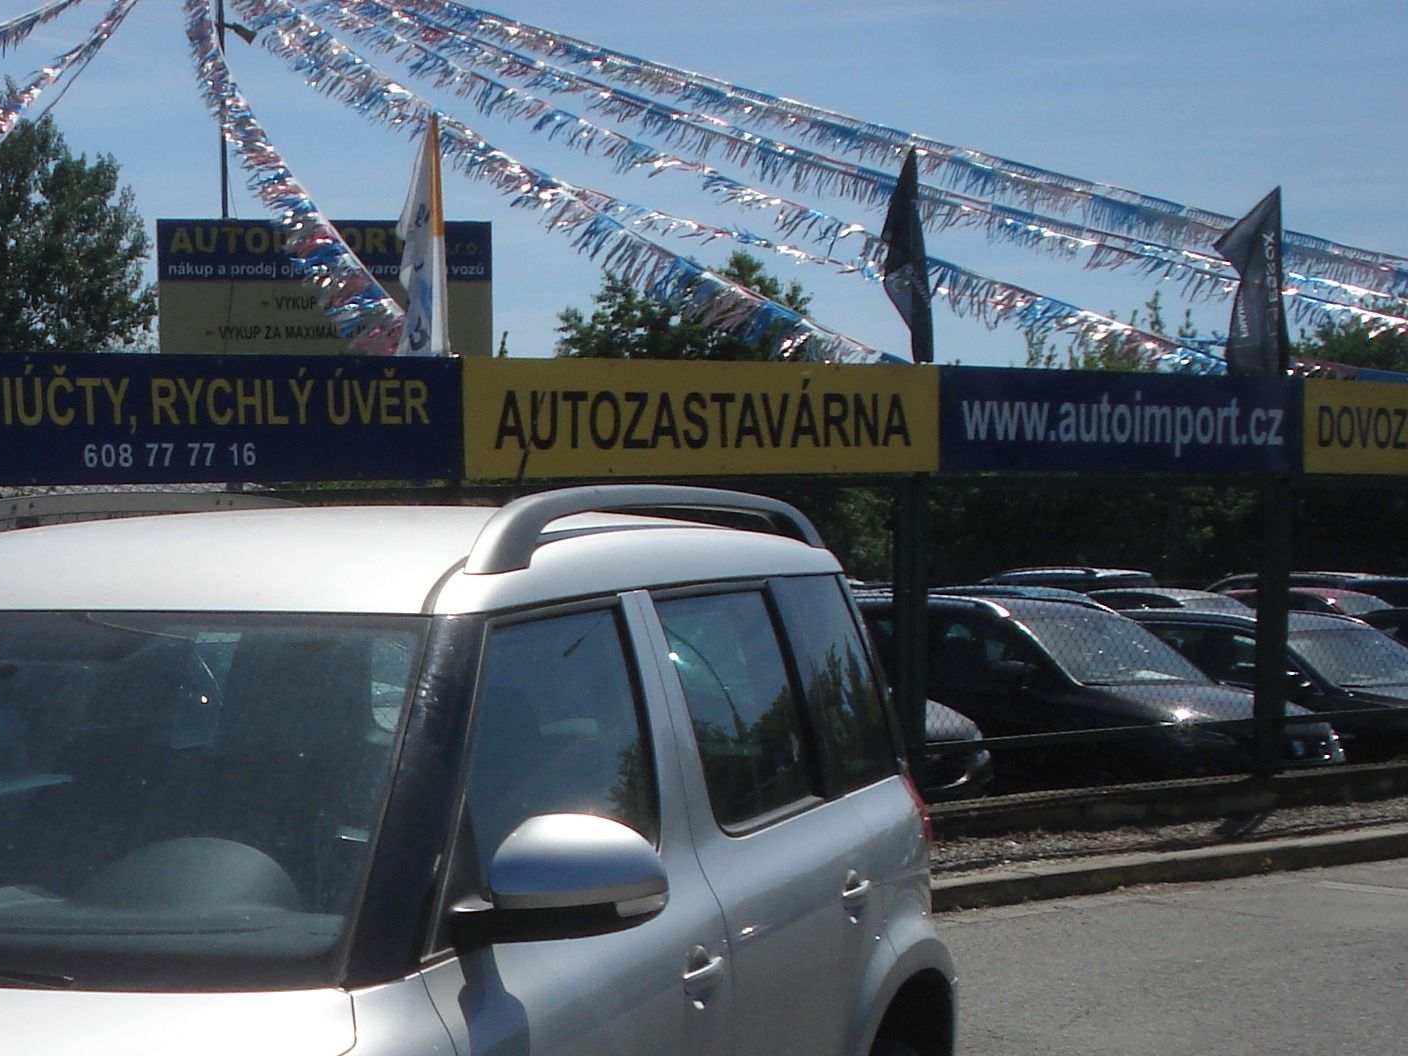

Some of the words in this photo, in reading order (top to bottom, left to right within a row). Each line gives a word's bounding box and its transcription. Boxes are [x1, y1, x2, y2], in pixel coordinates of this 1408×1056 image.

[169, 261, 213, 277] nákup
[218, 265, 226, 275] a
[231, 260, 276, 277] prodej
[265, 325, 281, 340] ZA
[150, 367, 314, 426] RYCHLÝ
[326, 367, 431, 425] ÚVĚR
[494, 378, 912, 450] AUTOZASTAVÁRNA
[962, 391, 1285, 457] www.autoimport.cz
[83, 442, 134, 468] 608
[145, 442, 175, 468] 77
[187, 442, 216, 467] 77
[228, 442, 257, 467] 16
